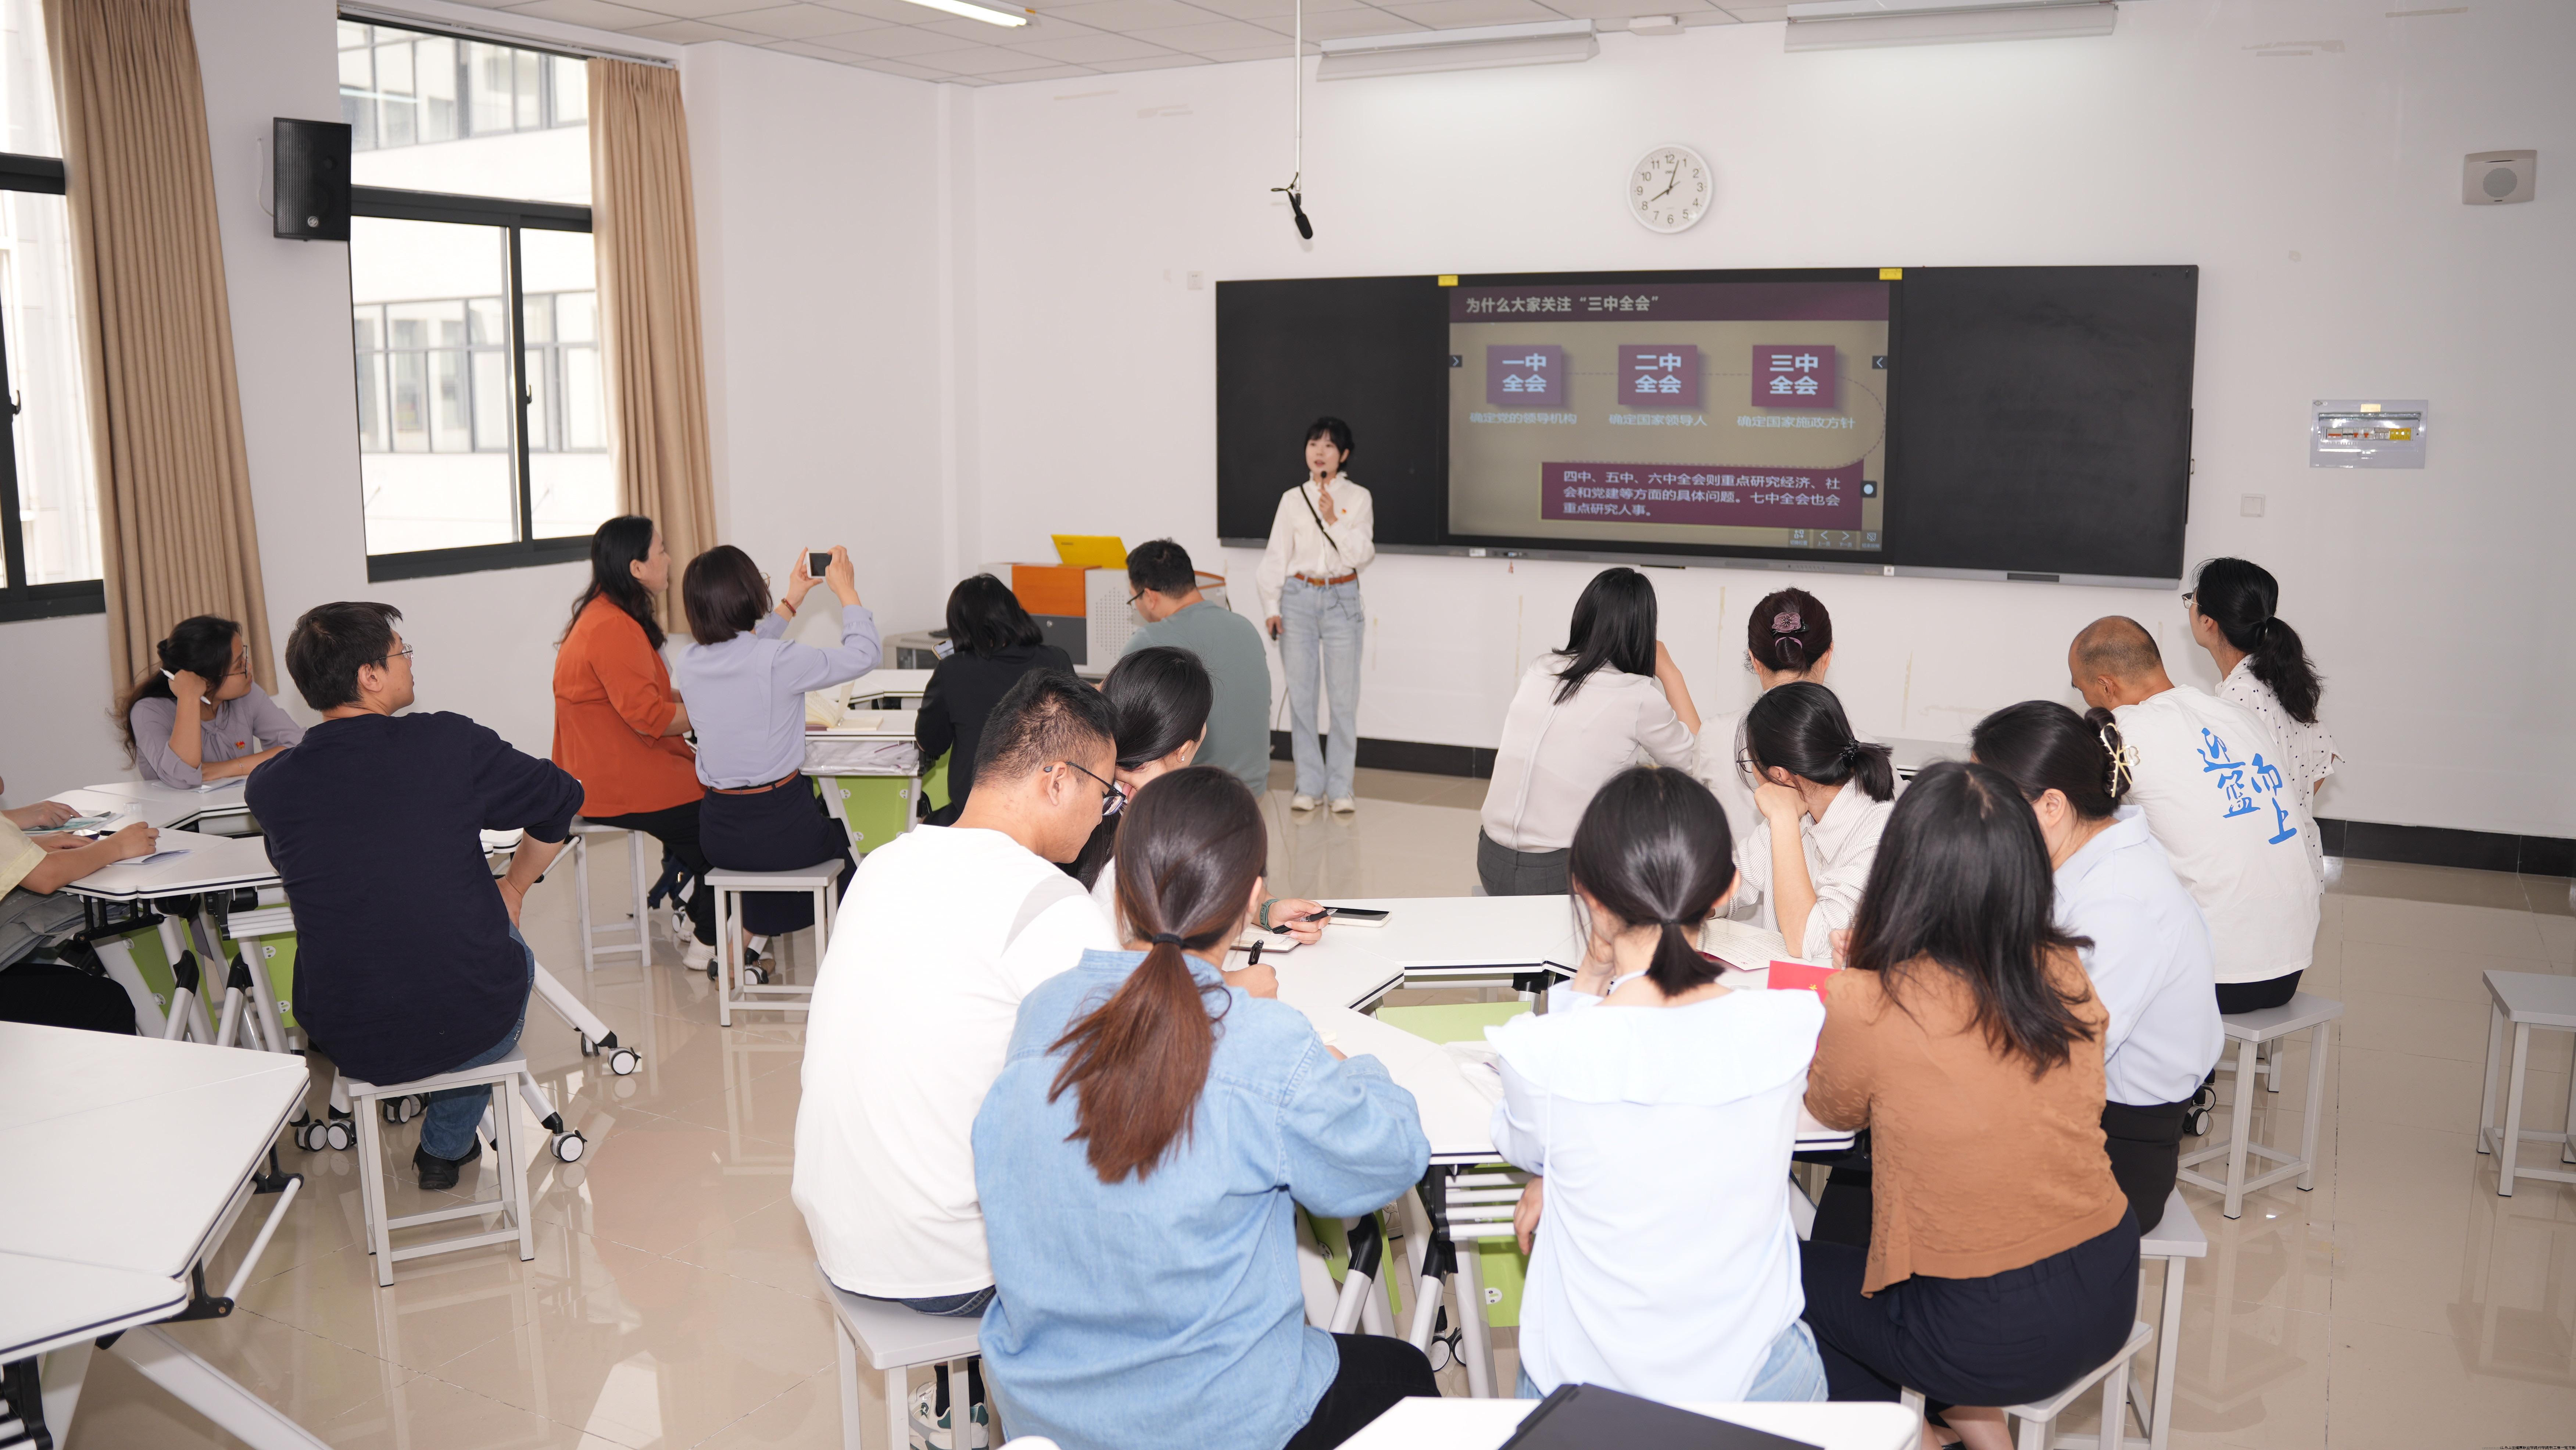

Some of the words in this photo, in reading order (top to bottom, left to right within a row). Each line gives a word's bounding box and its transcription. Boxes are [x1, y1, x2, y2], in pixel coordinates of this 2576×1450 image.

[1651, 160, 1660, 169] 11
[1665, 154, 1675, 164] 12
[1683, 158, 1686, 167] 1
[1641, 171, 1652, 181] 10
[1693, 168, 1699, 178] 2
[1636, 186, 1643, 196] 9
[1697, 182, 1703, 192] 3
[1642, 201, 1648, 210] 8
[1692, 197, 1699, 207] 4
[1653, 211, 1659, 221] 7
[1667, 214, 1674, 224] 6
[1682, 209, 1689, 219] 5
[1502, 353, 1546, 371] 一中
[1635, 353, 1681, 372] 二中
[1770, 353, 1818, 373] 三中
[1502, 374, 1547, 392] 全会
[1635, 374, 1681, 394] 全会
[1770, 375, 1818, 395] 全会
[1470, 412, 1577, 424] 确定党的领导机构
[1609, 414, 1707, 426] 确定国家领导人
[1737, 415, 1856, 429] 确定国家施政方针
[1564, 470, 1840, 490] 四中、五中、六中全会则重点研究经济、社
[1563, 486, 1840, 506] 会和党建等方面的具体问题。七中全会也会
[1563, 502, 1651, 516] 重点研究人事。
